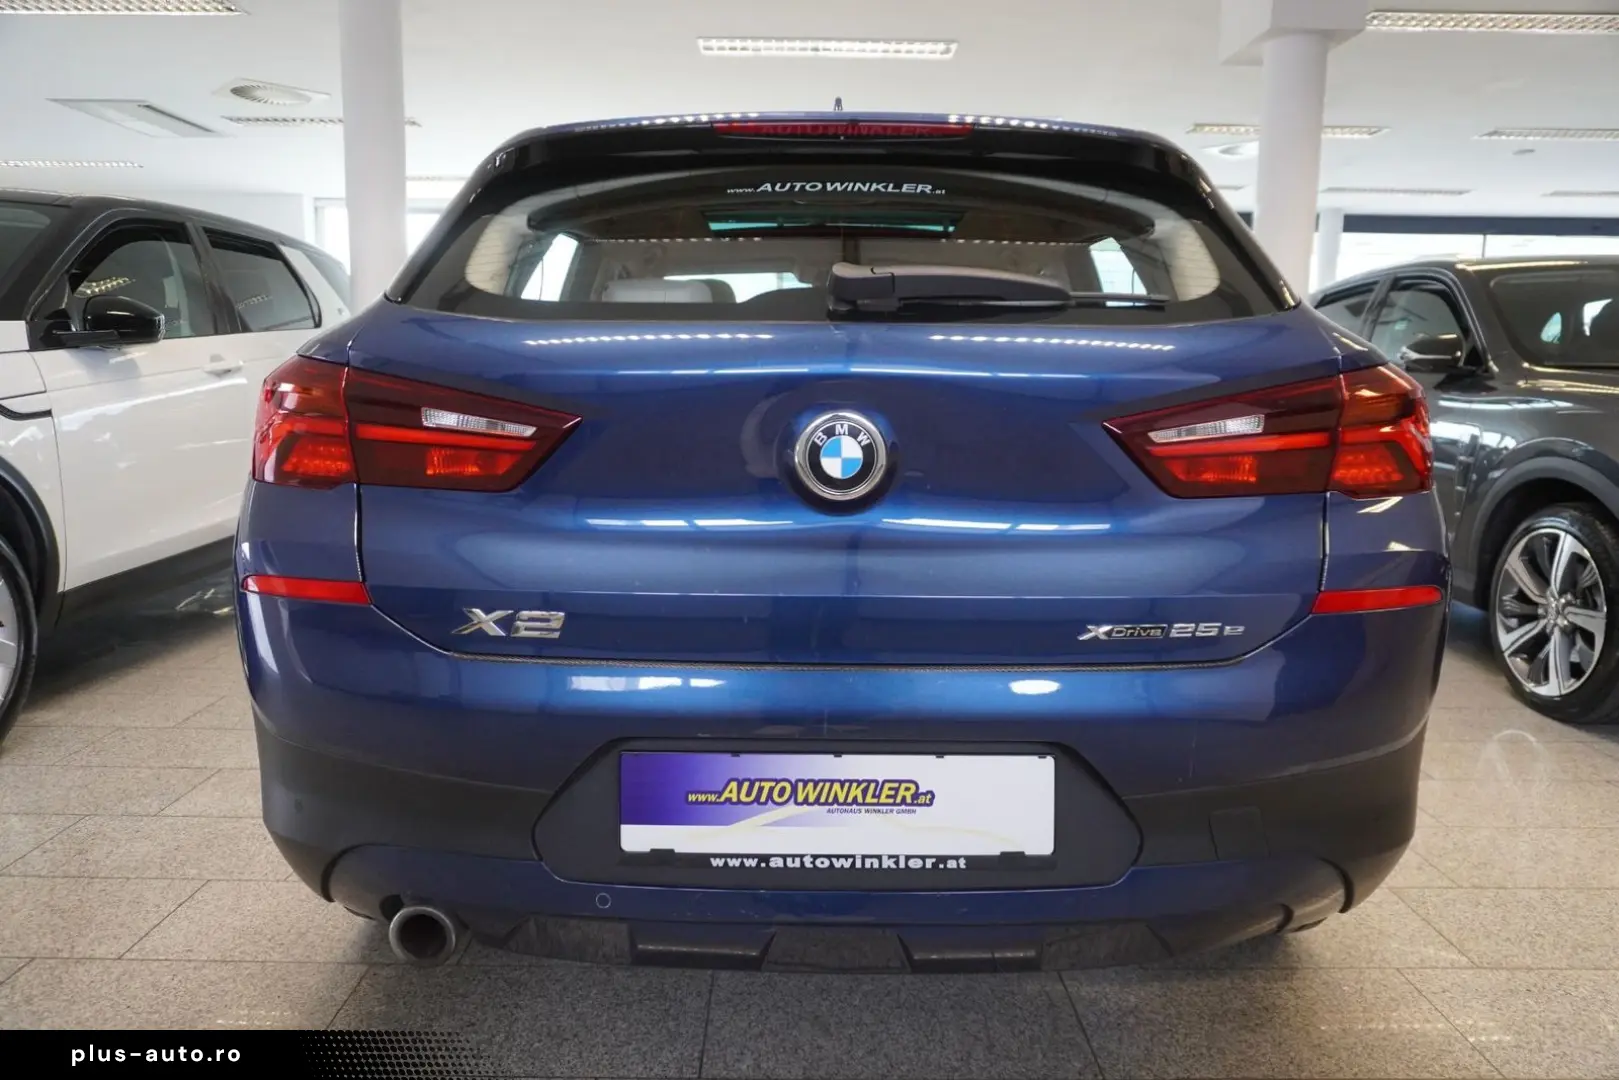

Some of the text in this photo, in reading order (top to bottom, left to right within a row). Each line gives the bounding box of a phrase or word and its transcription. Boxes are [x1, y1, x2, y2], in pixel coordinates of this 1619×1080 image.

[813, 423, 871, 447] BMW
[450, 607, 566, 639] X2
[826, 807, 862, 815] AUTOHAUS
[863, 807, 894, 815] WINKLER
[709, 854, 968, 870] www.autowinkler.at
